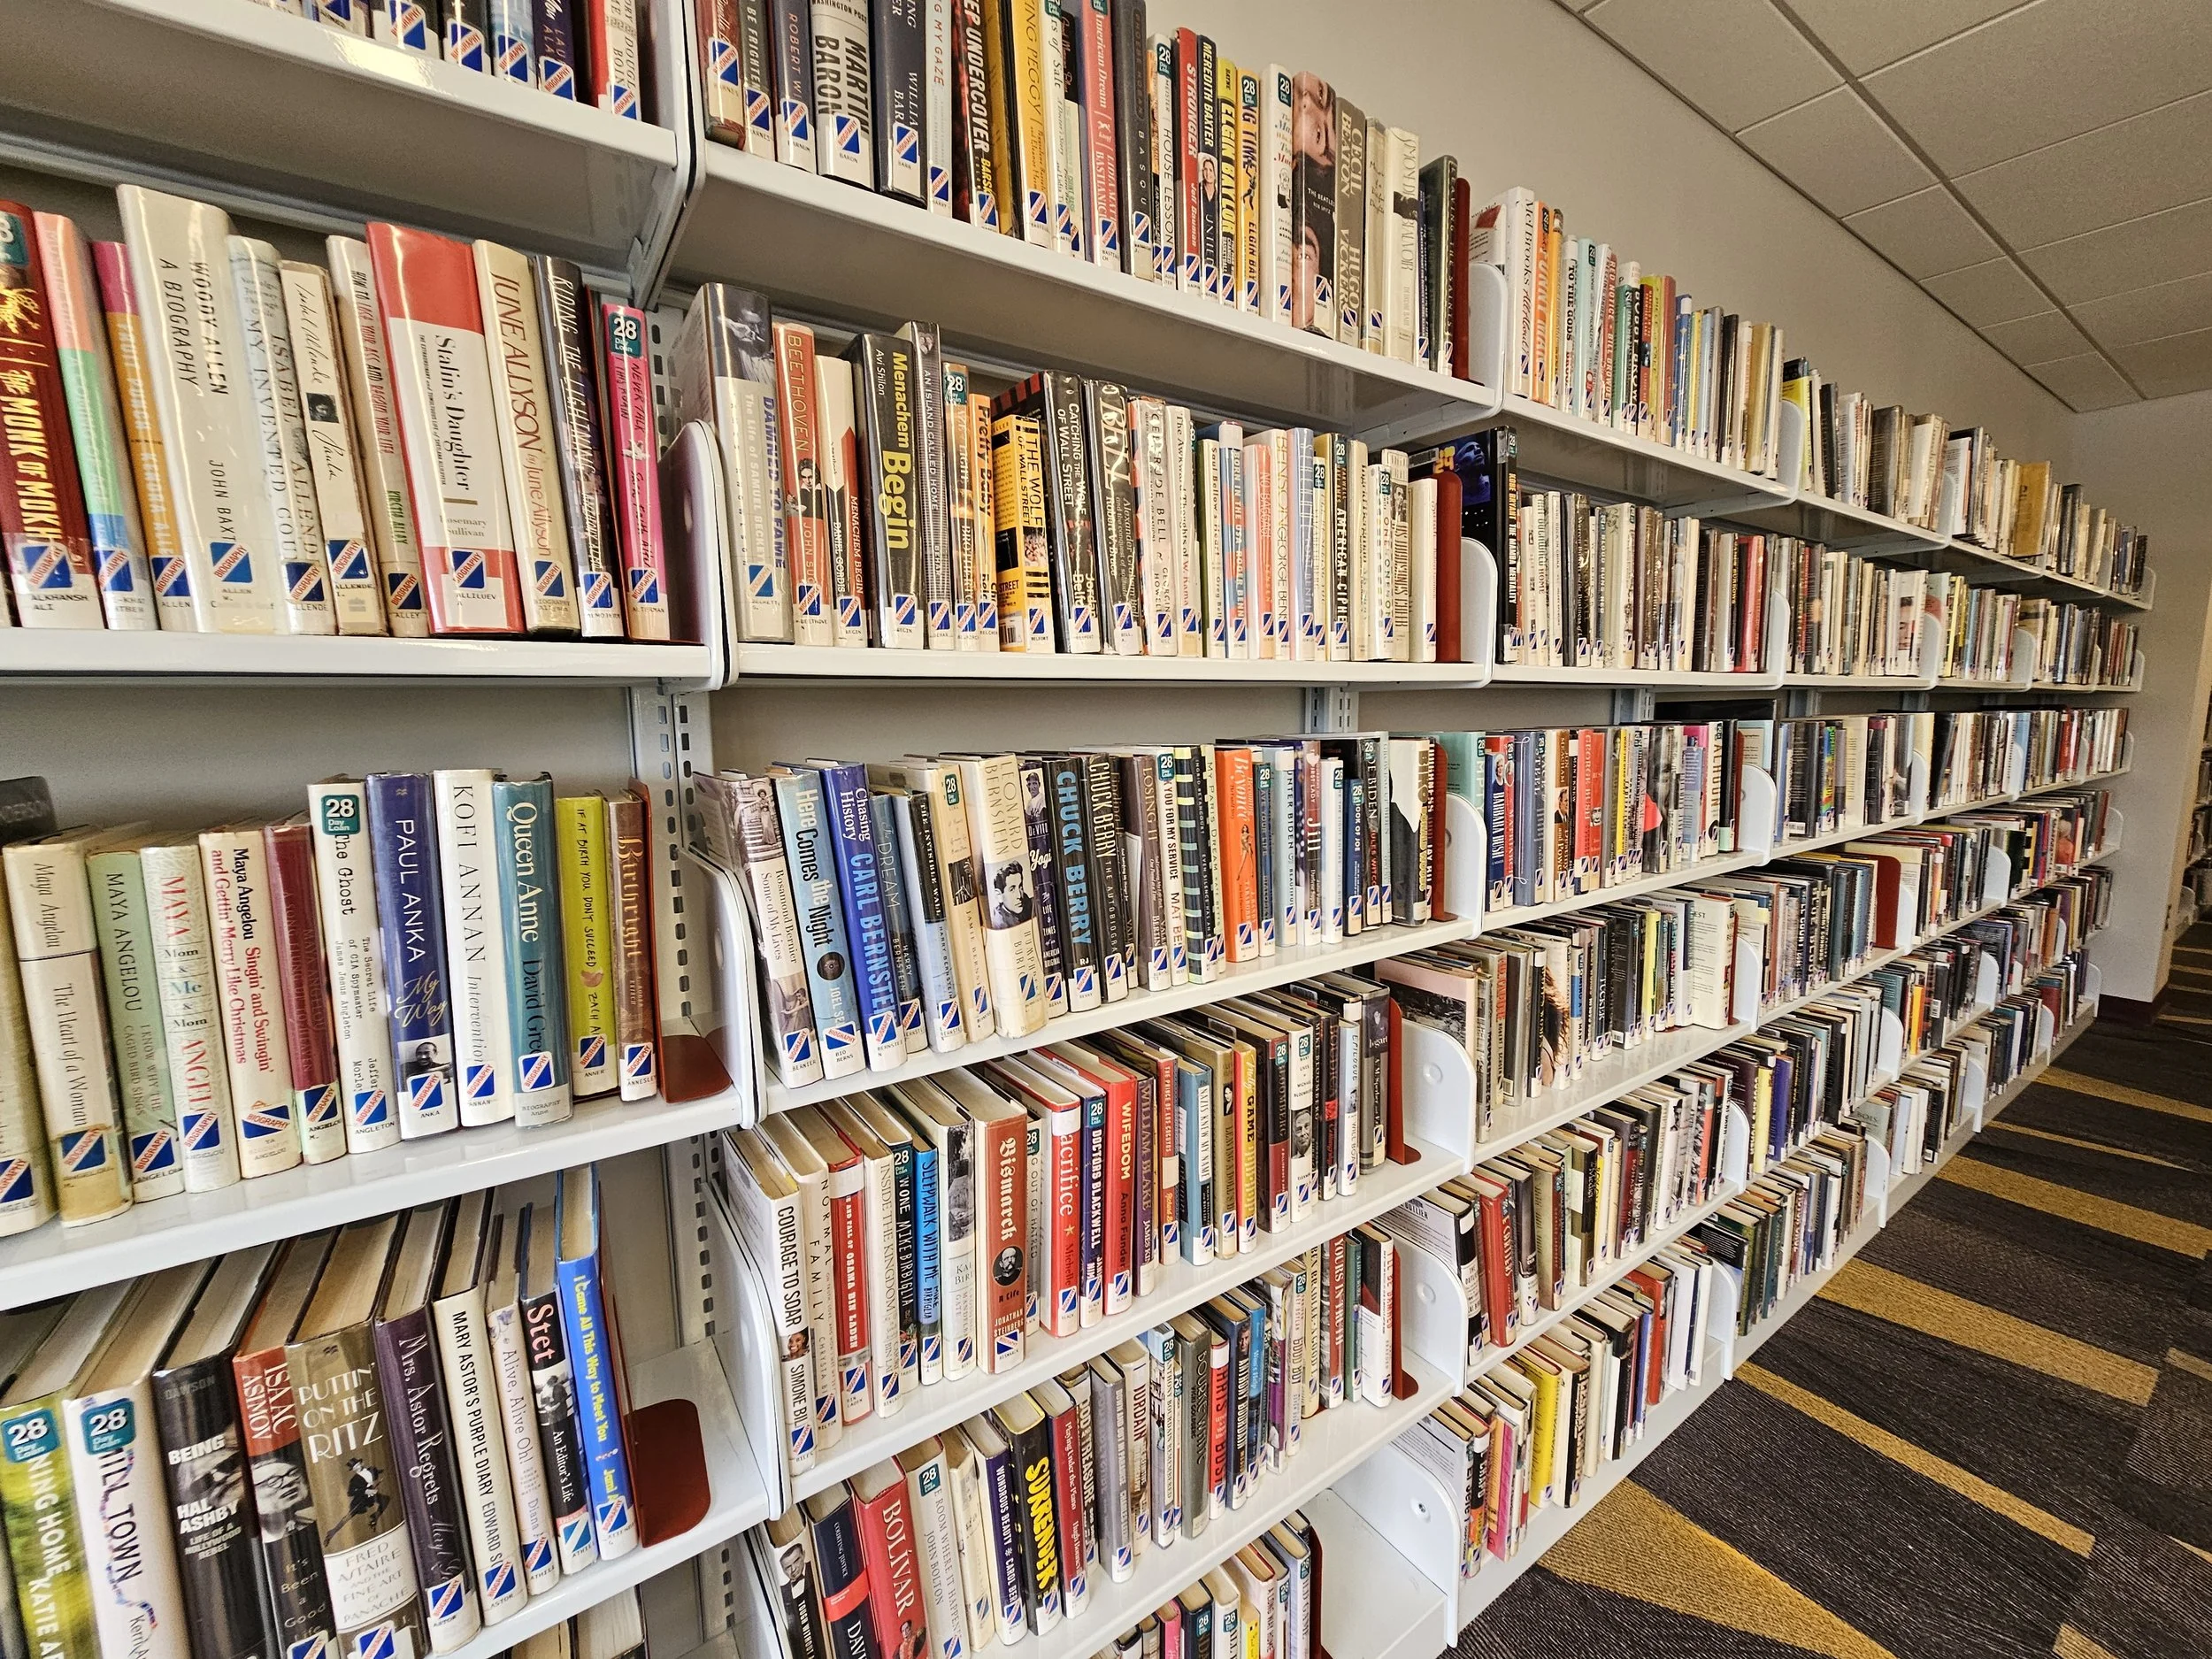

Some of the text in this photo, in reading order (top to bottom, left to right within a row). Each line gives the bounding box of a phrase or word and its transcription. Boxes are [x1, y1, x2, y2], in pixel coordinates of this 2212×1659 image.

[815, 35, 841, 114] BARON
[1026, 48, 1042, 114] PEGGY
[1159, 46, 1171, 64] 28
[1243, 78, 1255, 95] 28
[1279, 76, 1290, 93] 28
[966, 28, 990, 152] UNDERCOVER
[1186, 64, 1198, 157] STRONGER
[1202, 42, 1213, 147] MEREDITH BAXTER
[1163, 128, 1173, 244] HOUSE LESSON
[1221, 103, 1235, 234] ELGIN BAYLOR
[1341, 113, 1353, 197] BEATON
[1352, 128, 1364, 194] CECIL
[163, 279, 199, 386] BIOGRAPHY
[192, 261, 228, 396] WOODY ALLEN
[614, 316, 637, 339] 28
[270, 333, 298, 424] ISABEL
[435, 334, 472, 492] Stalin's Daughter
[786, 334, 810, 451] BEETHOVEN
[877, 364, 886, 396] Shilon
[892, 352, 910, 448] Menachem
[2, 396, 49, 480] MONK OF
[491, 272, 553, 557] JUNE ALLYSON Allyson
[1069, 403, 1081, 461] CATCHING
[763, 396, 787, 570] DAMNED FAME
[925, 388, 939, 511] ISLAND HOME
[1018, 453, 1028, 485] WALL
[1025, 437, 1043, 527] THE WOLF
[1335, 443, 1346, 457] 28
[879, 451, 917, 549] Begin
[1063, 464, 1074, 506] STREET
[945, 778, 957, 793] 28
[1161, 756, 1173, 769] 28
[326, 799, 354, 818] 28
[841, 791, 856, 841] History
[855, 788, 872, 843] Chasing
[985, 764, 1010, 856] BERNSTEIN
[998, 761, 1023, 849] LEONARD
[1089, 762, 1117, 858] CHUCK BERRY
[1307, 818, 1321, 852] Jill
[233, 848, 250, 883] Maya
[453, 785, 487, 962] KOFI ANNAN
[506, 802, 544, 943] Queen Anne
[795, 790, 834, 948] Here Comes the Night
[878, 842, 901, 908] DREAM
[1029, 844, 1051, 870] Yogi
[1056, 771, 1092, 944] CHUCK BERRY
[1167, 843, 1179, 880] SERVICE
[1492, 826, 1503, 858] BUSH
[161, 876, 190, 938] MAYA
[237, 885, 256, 941] Angelou
[337, 869, 357, 916] Ghost
[396, 818, 426, 964] PAUL ANKA
[618, 835, 644, 958] Birthright
[774, 869, 791, 923] Rosamond
[850, 853, 875, 910] CARL
[1171, 892, 1181, 922] MAT
[106, 872, 142, 1012] MAYA ANGELOU
[171, 980, 203, 995] Me
[219, 926, 248, 1064] Merry Christmas
[395, 1000, 449, 1026] Way
[525, 1056, 551, 1090] BIOGRAPHY
[1090, 1101, 1104, 1117] 28
[1120, 1101, 1132, 1180] WIFEDOM
[895, 1150, 909, 1165] 28
[998, 1138, 1018, 1240] Bismarck
[821, 1179, 833, 1265] NORMAL
[1091, 1183, 1102, 1249] BLACKWELL
[778, 1205, 803, 1327] COURAGE TO SOAR
[810, 1240, 824, 1321] FAMILY
[896, 1220, 914, 1306] MIKE BIRBIGLIA
[526, 1305, 555, 1362] Stet
[242, 1375, 272, 1440] ASIMOV
[265, 1363, 298, 1435] ISAAC
[303, 1387, 378, 1428] ON THE
[790, 1363, 807, 1405] SIMONE
[7, 1417, 48, 1445] 28
[89, 1409, 127, 1435] 28
[168, 1434, 226, 1465] BEING
[308, 1411, 383, 1463] RITZ
[408, 1382, 443, 1505] Astor Regrets
[452, 1310, 500, 1555] MARY ASTOR'S PURPLE DIARY EDWARD
[922, 1468, 936, 1485] 28
[107, 1502, 142, 1583] TOWN
[180, 1502, 239, 1534] ASHBY
[995, 1465, 1017, 1586] WONDROUS BEAUTY CAROL
[1025, 1456, 1058, 1589] SURRENDER
[883, 1499, 915, 1617] BOLÍVAR
[925, 1531, 944, 1605] JOHN BOLTON
